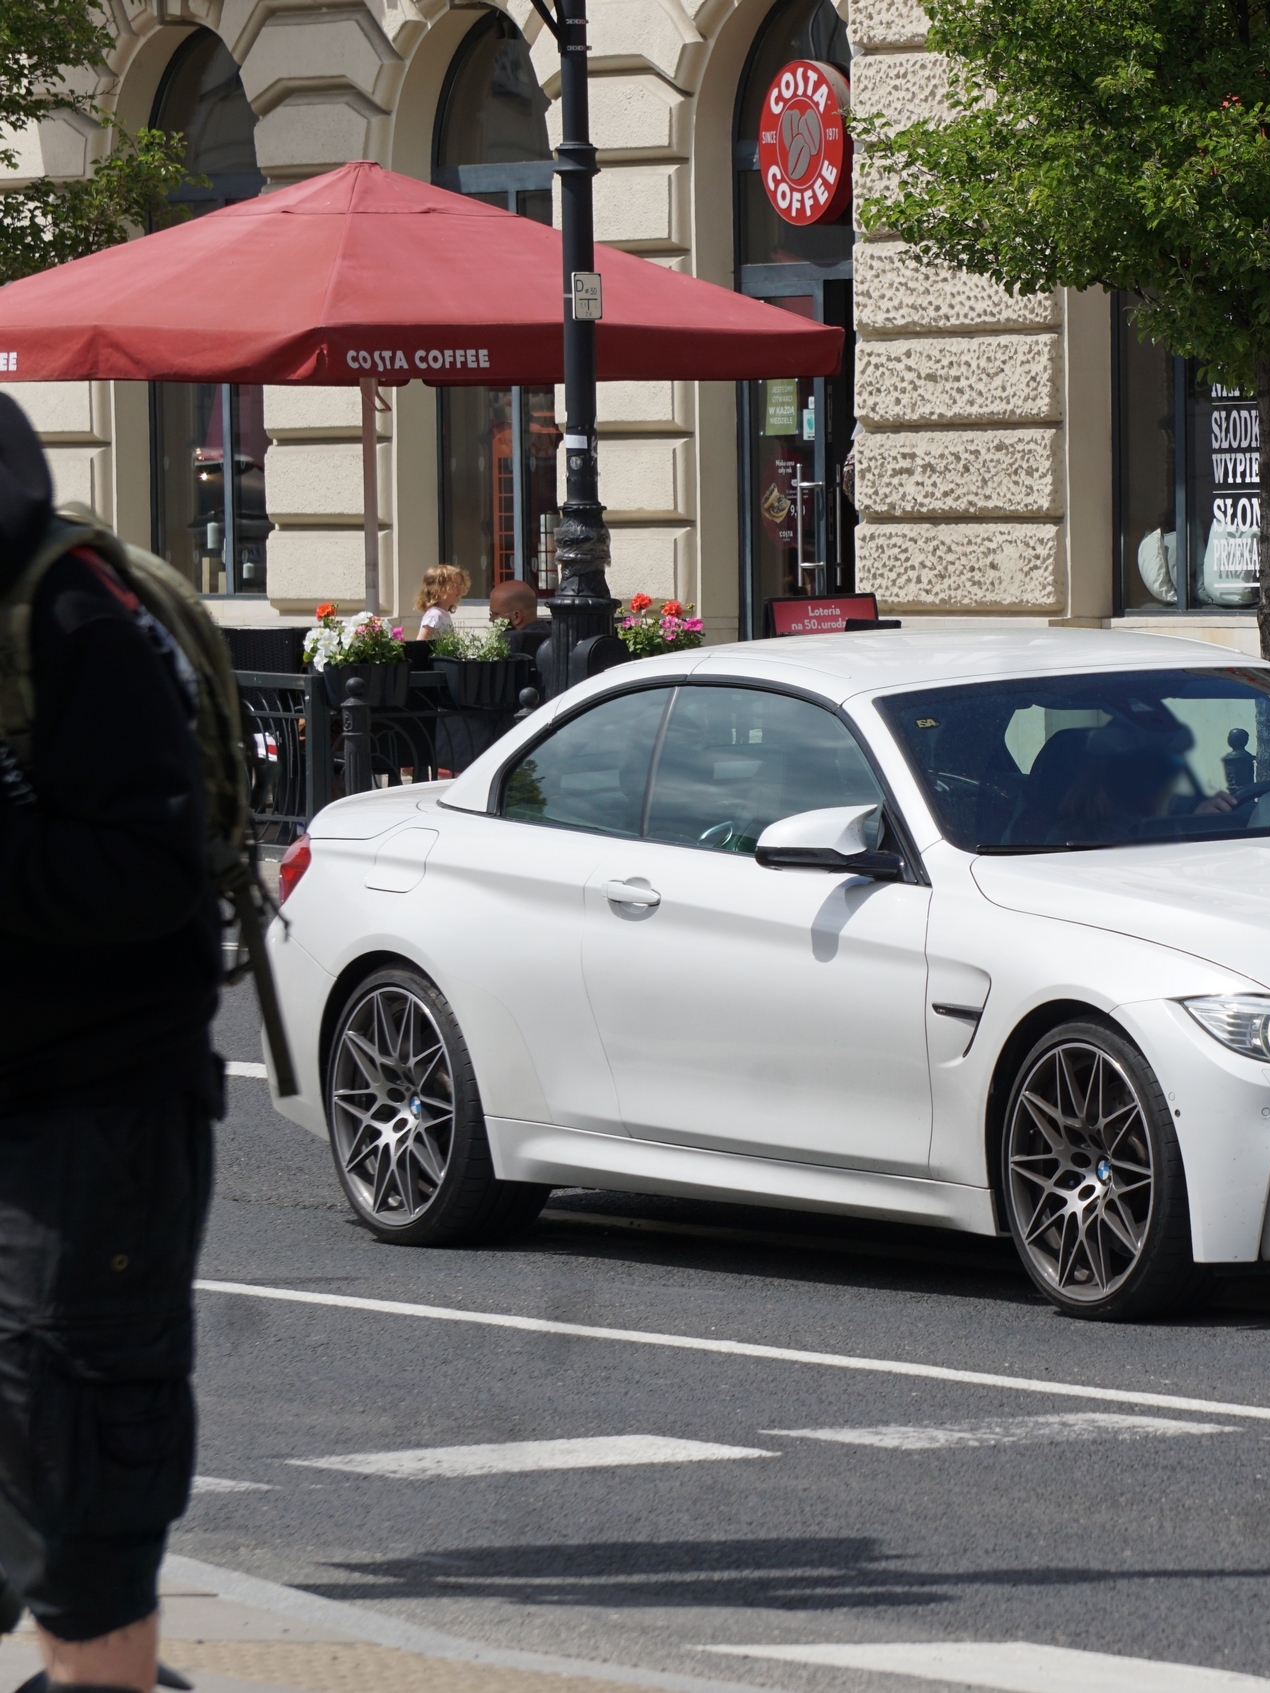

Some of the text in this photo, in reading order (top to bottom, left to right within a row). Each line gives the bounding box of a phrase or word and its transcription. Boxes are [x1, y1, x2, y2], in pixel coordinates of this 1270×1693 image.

[769, 67, 829, 115] COSTA
[762, 127, 839, 145] SINCE 1971
[767, 159, 837, 218] COFFEE
[575, 279, 584, 292] D
[346, 348, 490, 372] COSTA COFFEE
[1213, 537, 1261, 578] PRZEKĄ
[808, 605, 841, 617] Loteria
